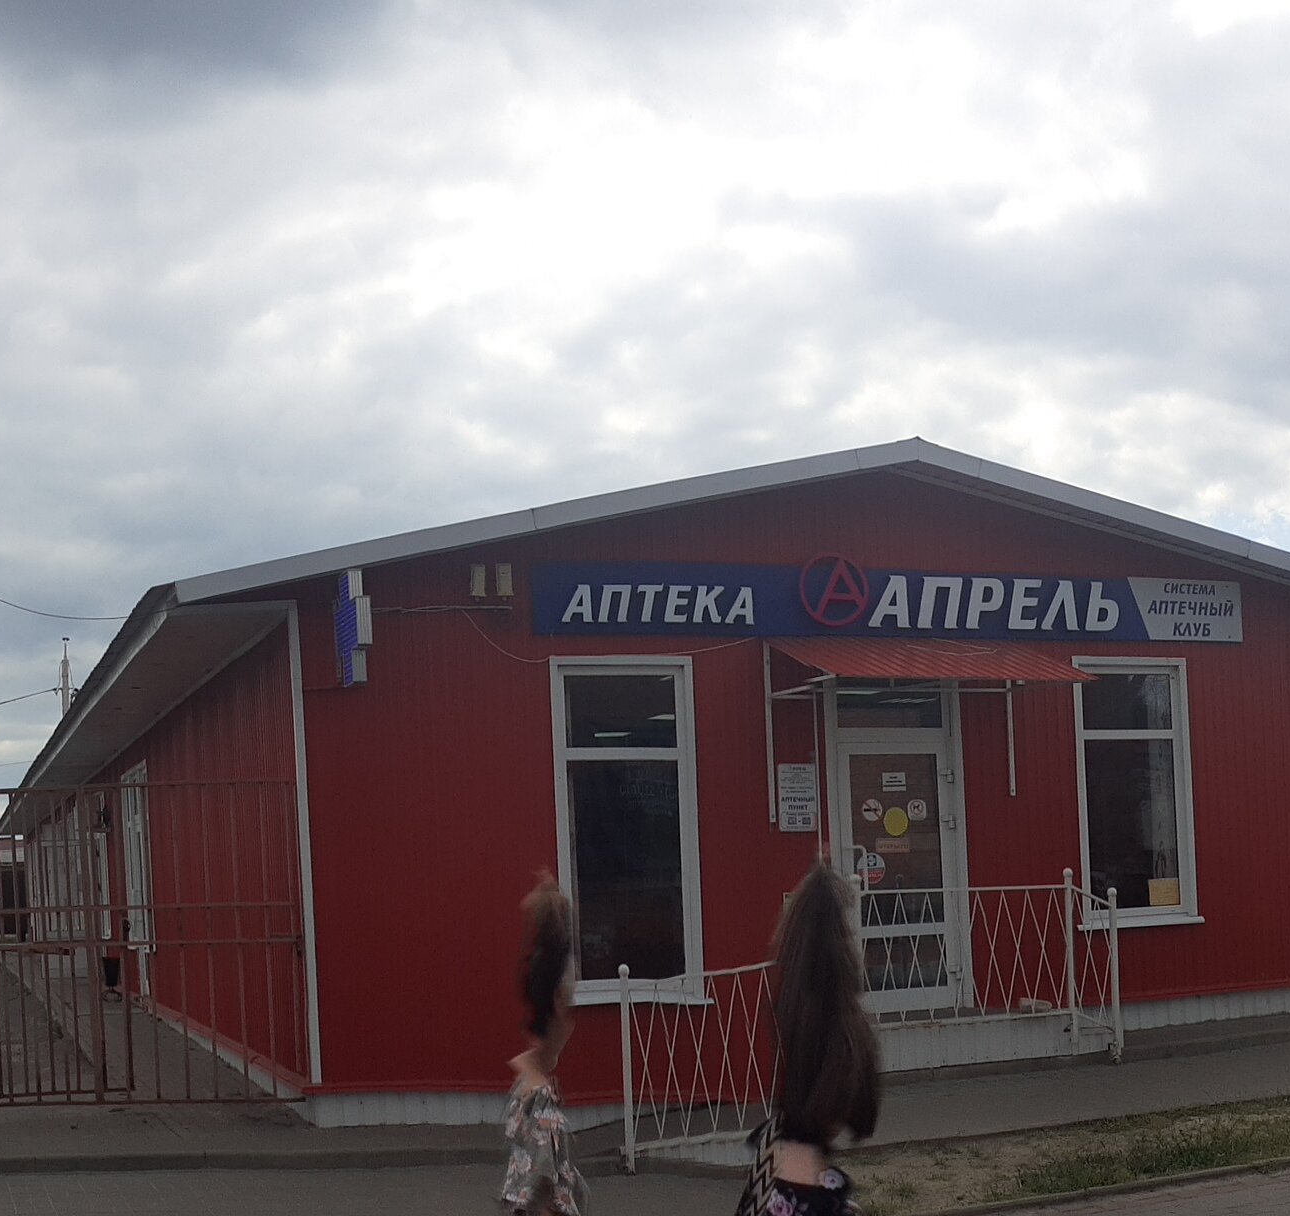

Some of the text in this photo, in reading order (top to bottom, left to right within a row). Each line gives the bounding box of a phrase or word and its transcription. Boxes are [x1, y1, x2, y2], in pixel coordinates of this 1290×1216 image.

[1163, 581, 1218, 596] СИСТЕМА
[562, 584, 755, 626] АПТЕКА
[868, 575, 1120, 632] АПРЕЛЬ
[1147, 598, 1235, 618] АПТЕЧНЫЙ
[1172, 622, 1212, 638] КЛУБ
